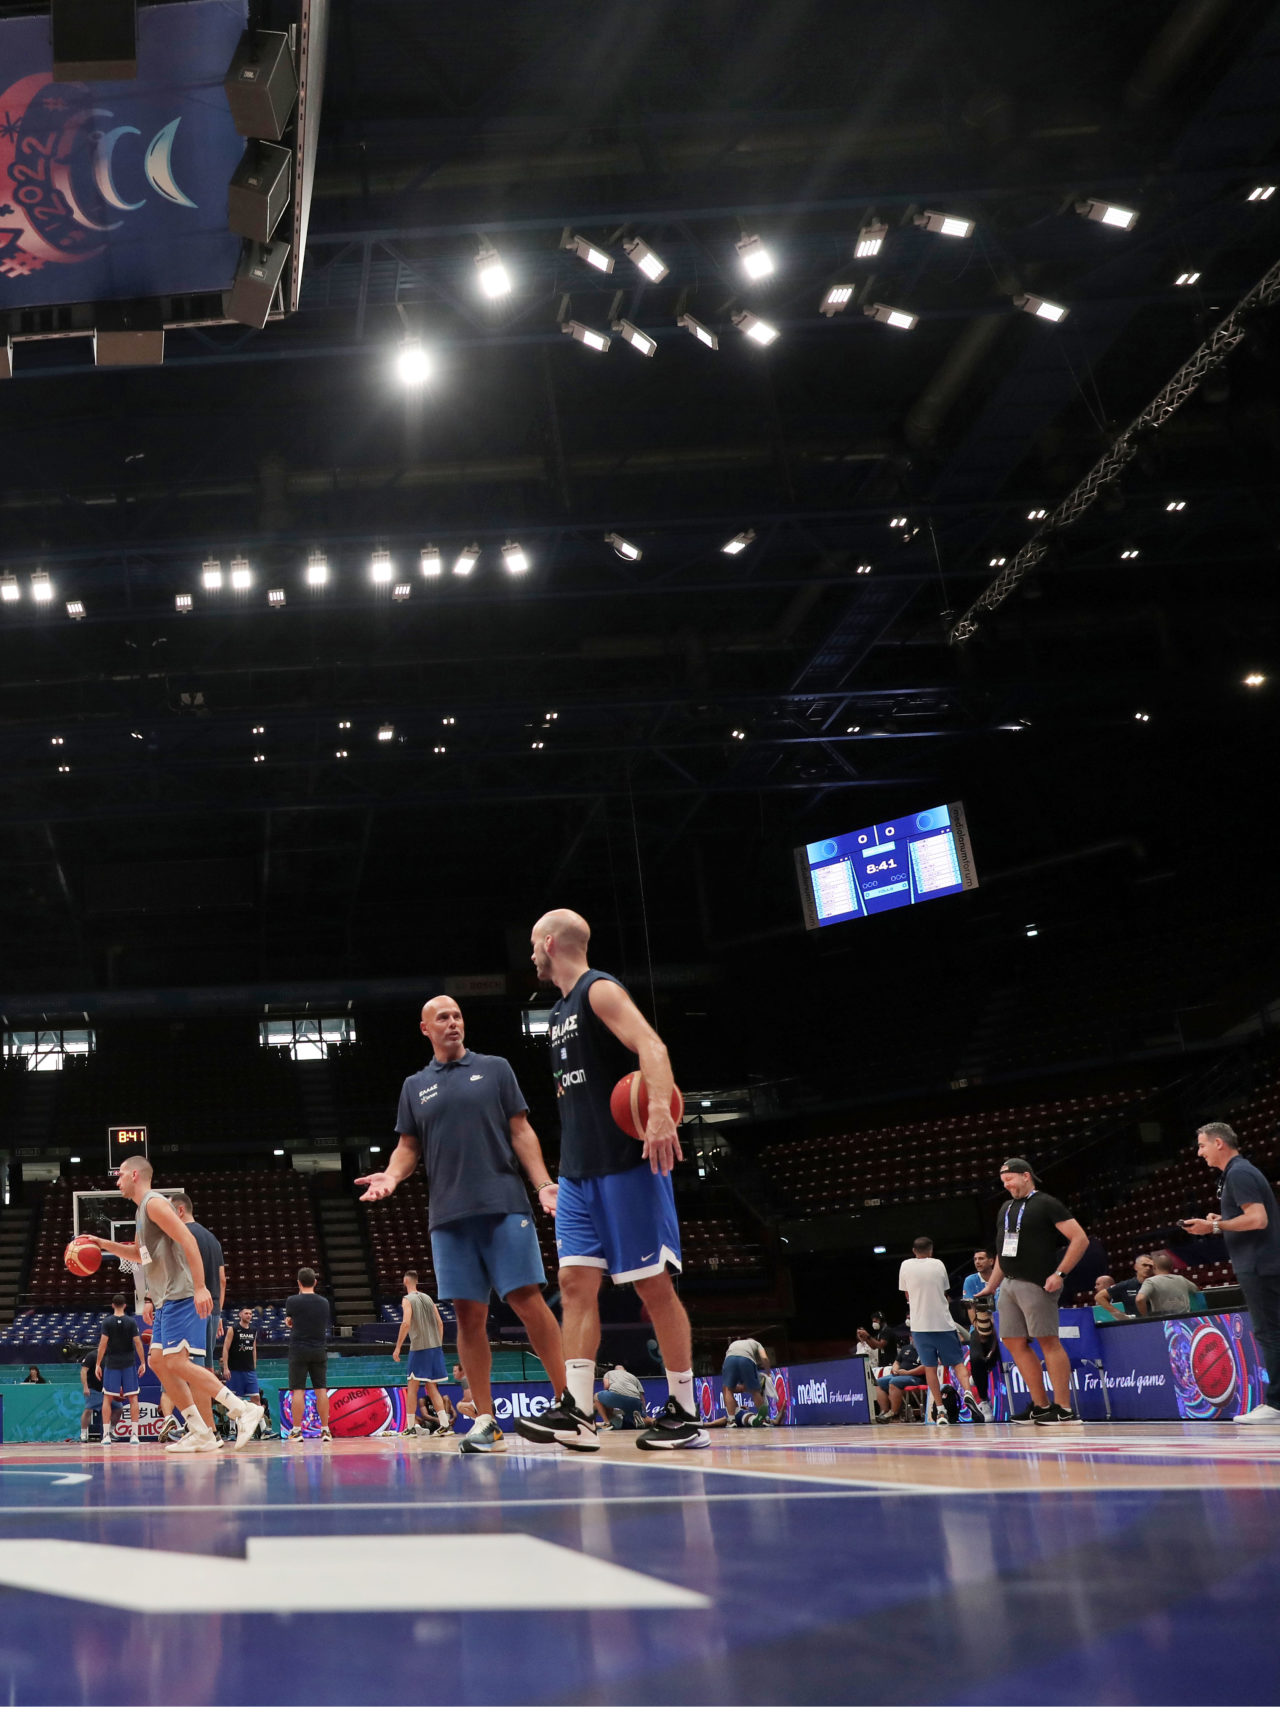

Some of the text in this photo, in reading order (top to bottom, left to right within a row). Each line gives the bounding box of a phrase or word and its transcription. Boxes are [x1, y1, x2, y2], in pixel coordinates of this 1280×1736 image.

[866, 858, 897, 874] 8:41
[119, 1131, 144, 1143] 8:41
[1084, 1373, 1098, 1391] For
[1116, 1369, 1136, 1388] real
[1137, 1374, 1166, 1394] game
[798, 1379, 828, 1405] molten
